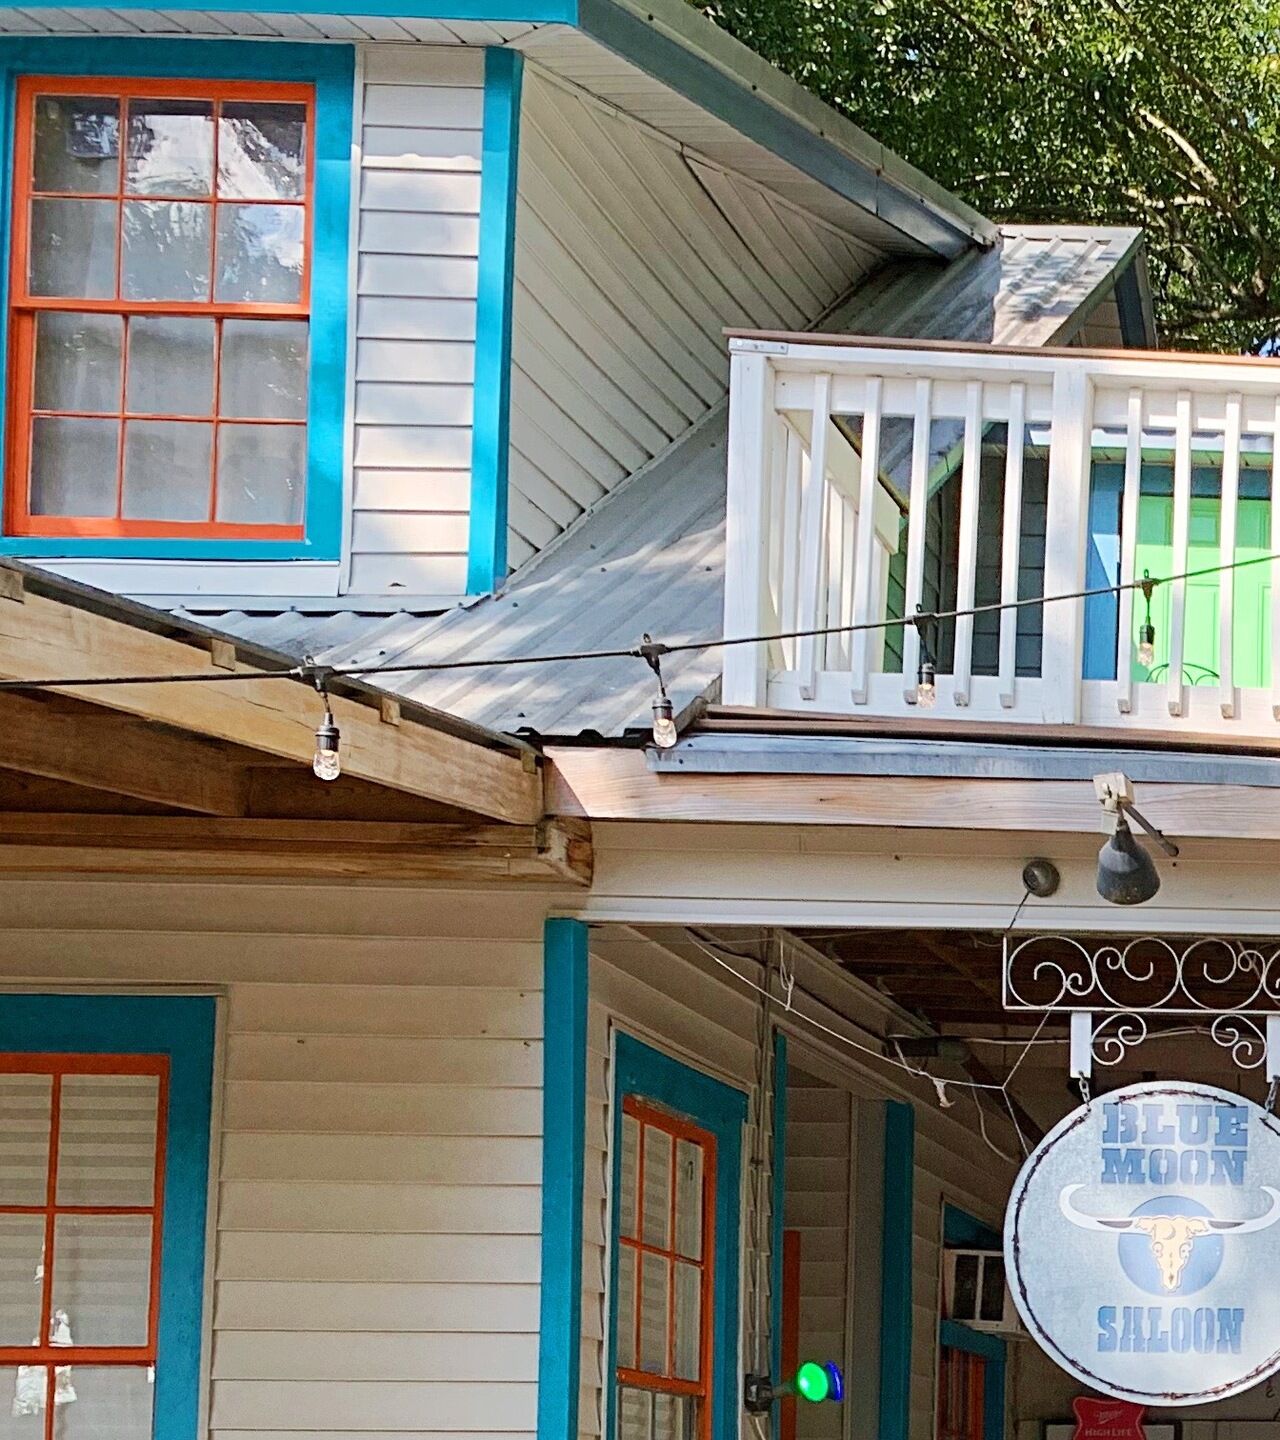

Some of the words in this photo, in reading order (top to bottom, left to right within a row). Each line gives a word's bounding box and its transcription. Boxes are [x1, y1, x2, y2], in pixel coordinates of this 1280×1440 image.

[1102, 1103, 1249, 1147] BLUE
[1101, 1149, 1248, 1185] MOON
[1097, 1306, 1244, 1354] SALOON
